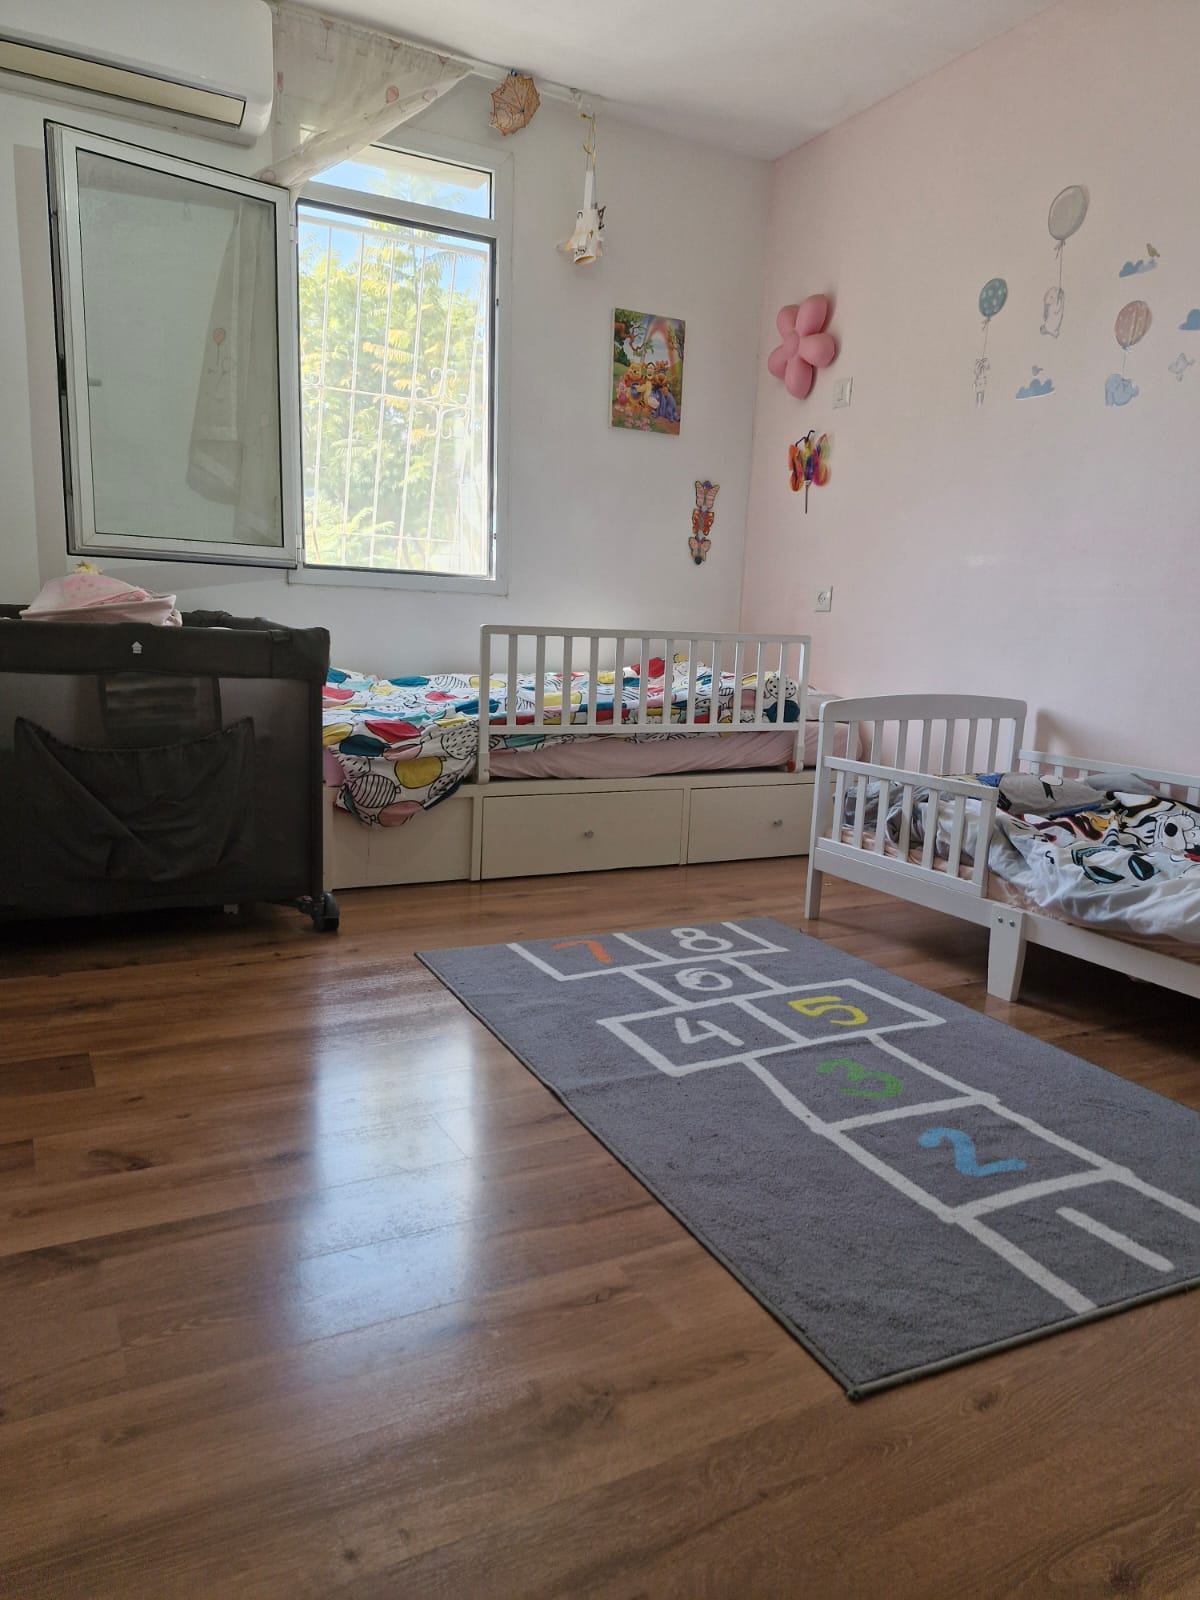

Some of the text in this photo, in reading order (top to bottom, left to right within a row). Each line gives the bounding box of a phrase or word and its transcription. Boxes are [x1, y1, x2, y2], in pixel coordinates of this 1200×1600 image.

[551, 939, 613, 964] 7
[670, 927, 734, 952] 8
[674, 967, 734, 991] 6
[788, 995, 868, 1026] 5
[674, 1016, 744, 1046] 4
[815, 1057, 904, 1098] 3
[917, 1127, 1026, 1177] 2
[1055, 1206, 1174, 1272] 1
